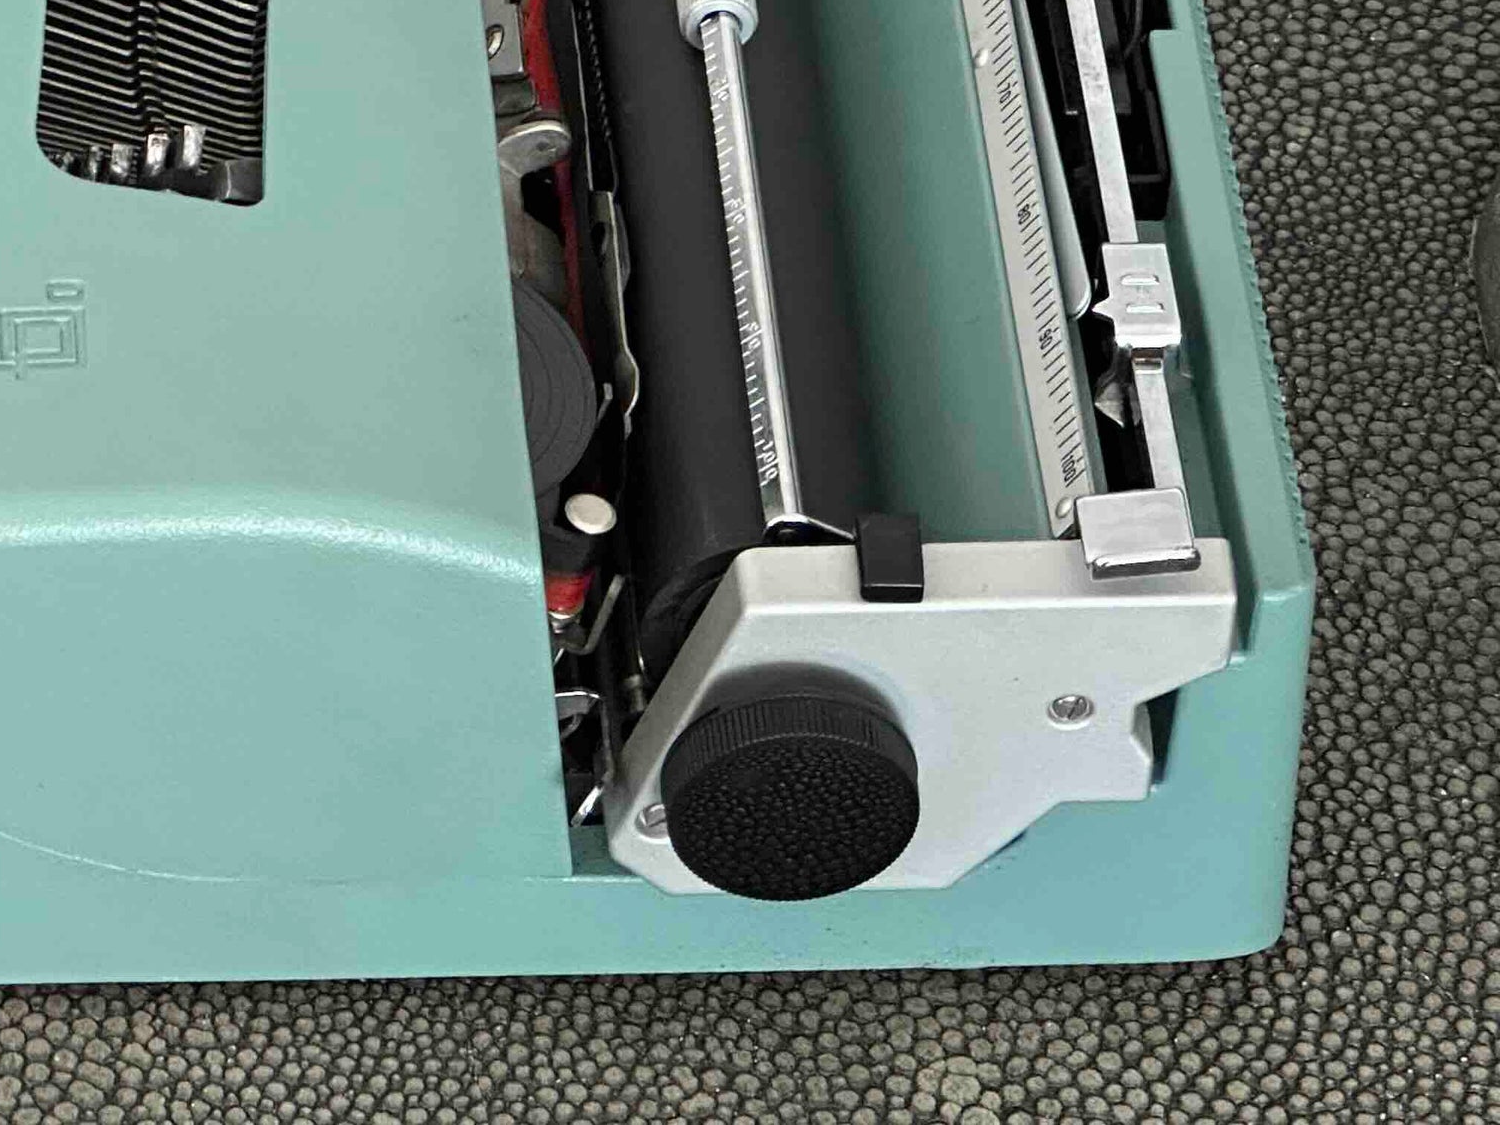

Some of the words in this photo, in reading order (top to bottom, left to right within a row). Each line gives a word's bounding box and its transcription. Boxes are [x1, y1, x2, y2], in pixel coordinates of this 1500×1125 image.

[997, 85, 1012, 104] 70
[1017, 204, 1031, 223] 80
[1038, 328, 1056, 350] 90
[1060, 454, 1078, 483] 100
